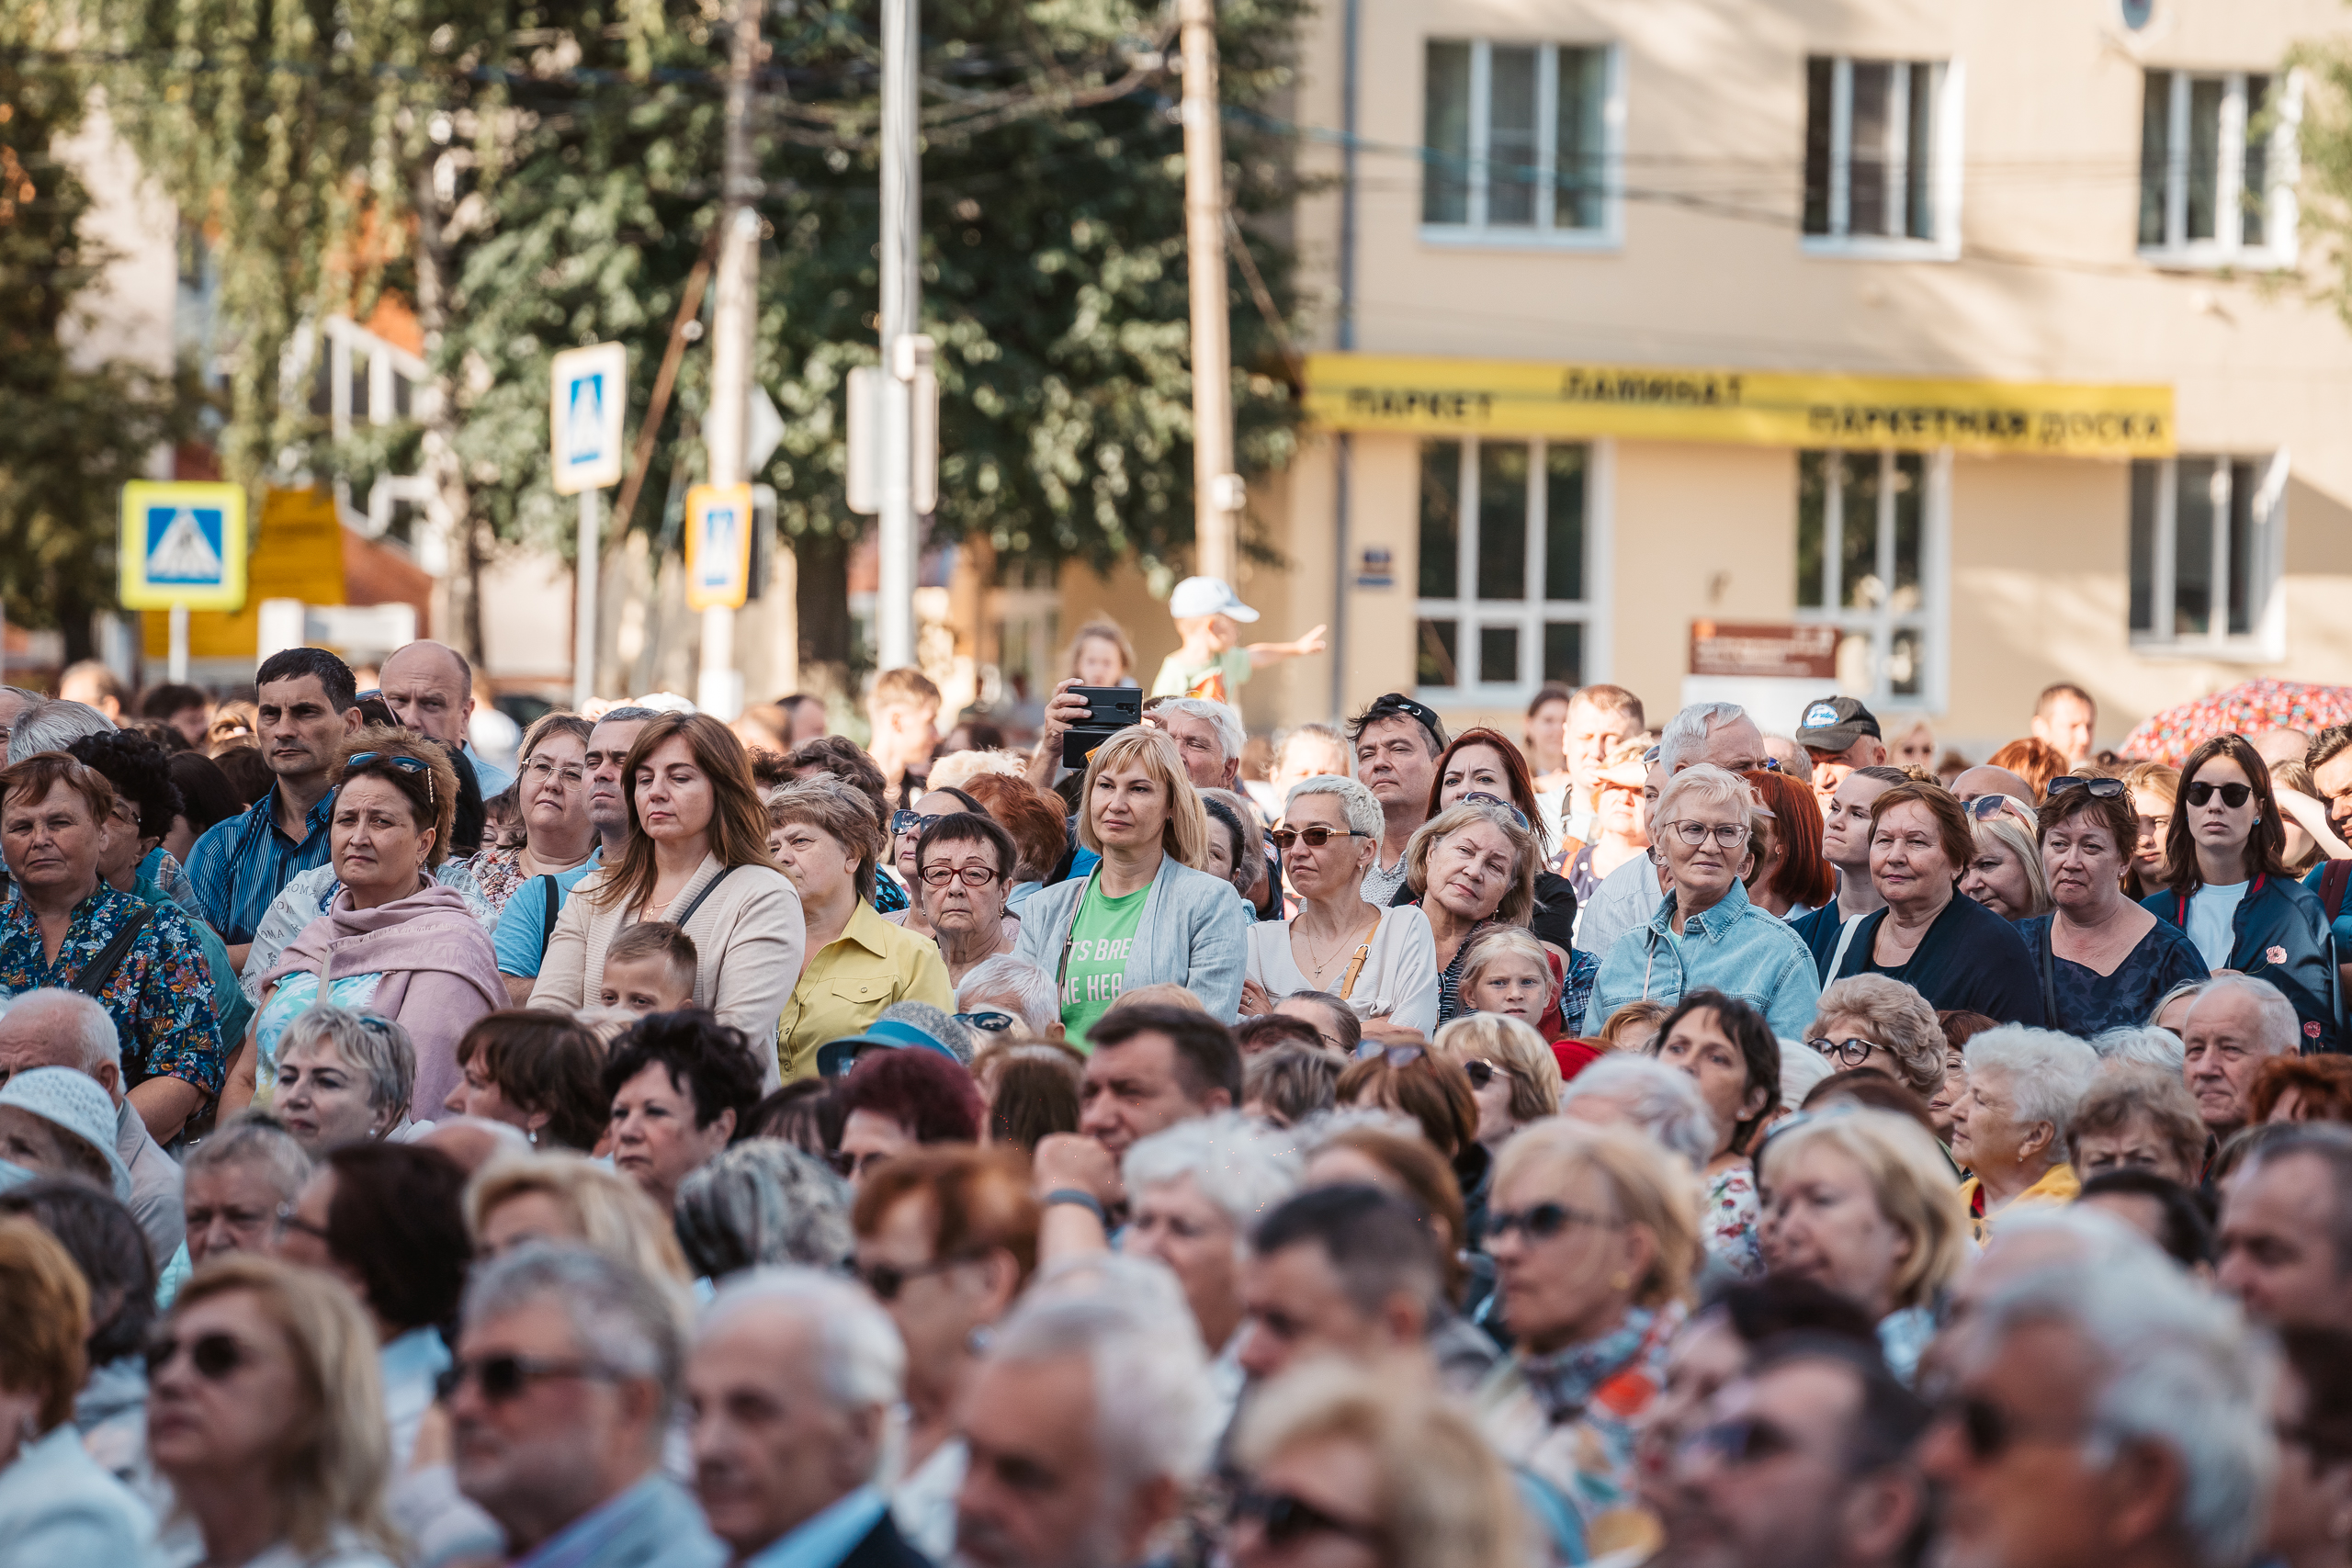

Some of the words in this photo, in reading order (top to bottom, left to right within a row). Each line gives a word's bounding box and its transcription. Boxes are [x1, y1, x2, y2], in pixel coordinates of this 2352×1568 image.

[1346, 387, 1492, 419] ПАРКЕТ
[1807, 405, 2030, 439] ПАРКЕТНАЯ
[2040, 412, 2164, 445] ДОСКА
